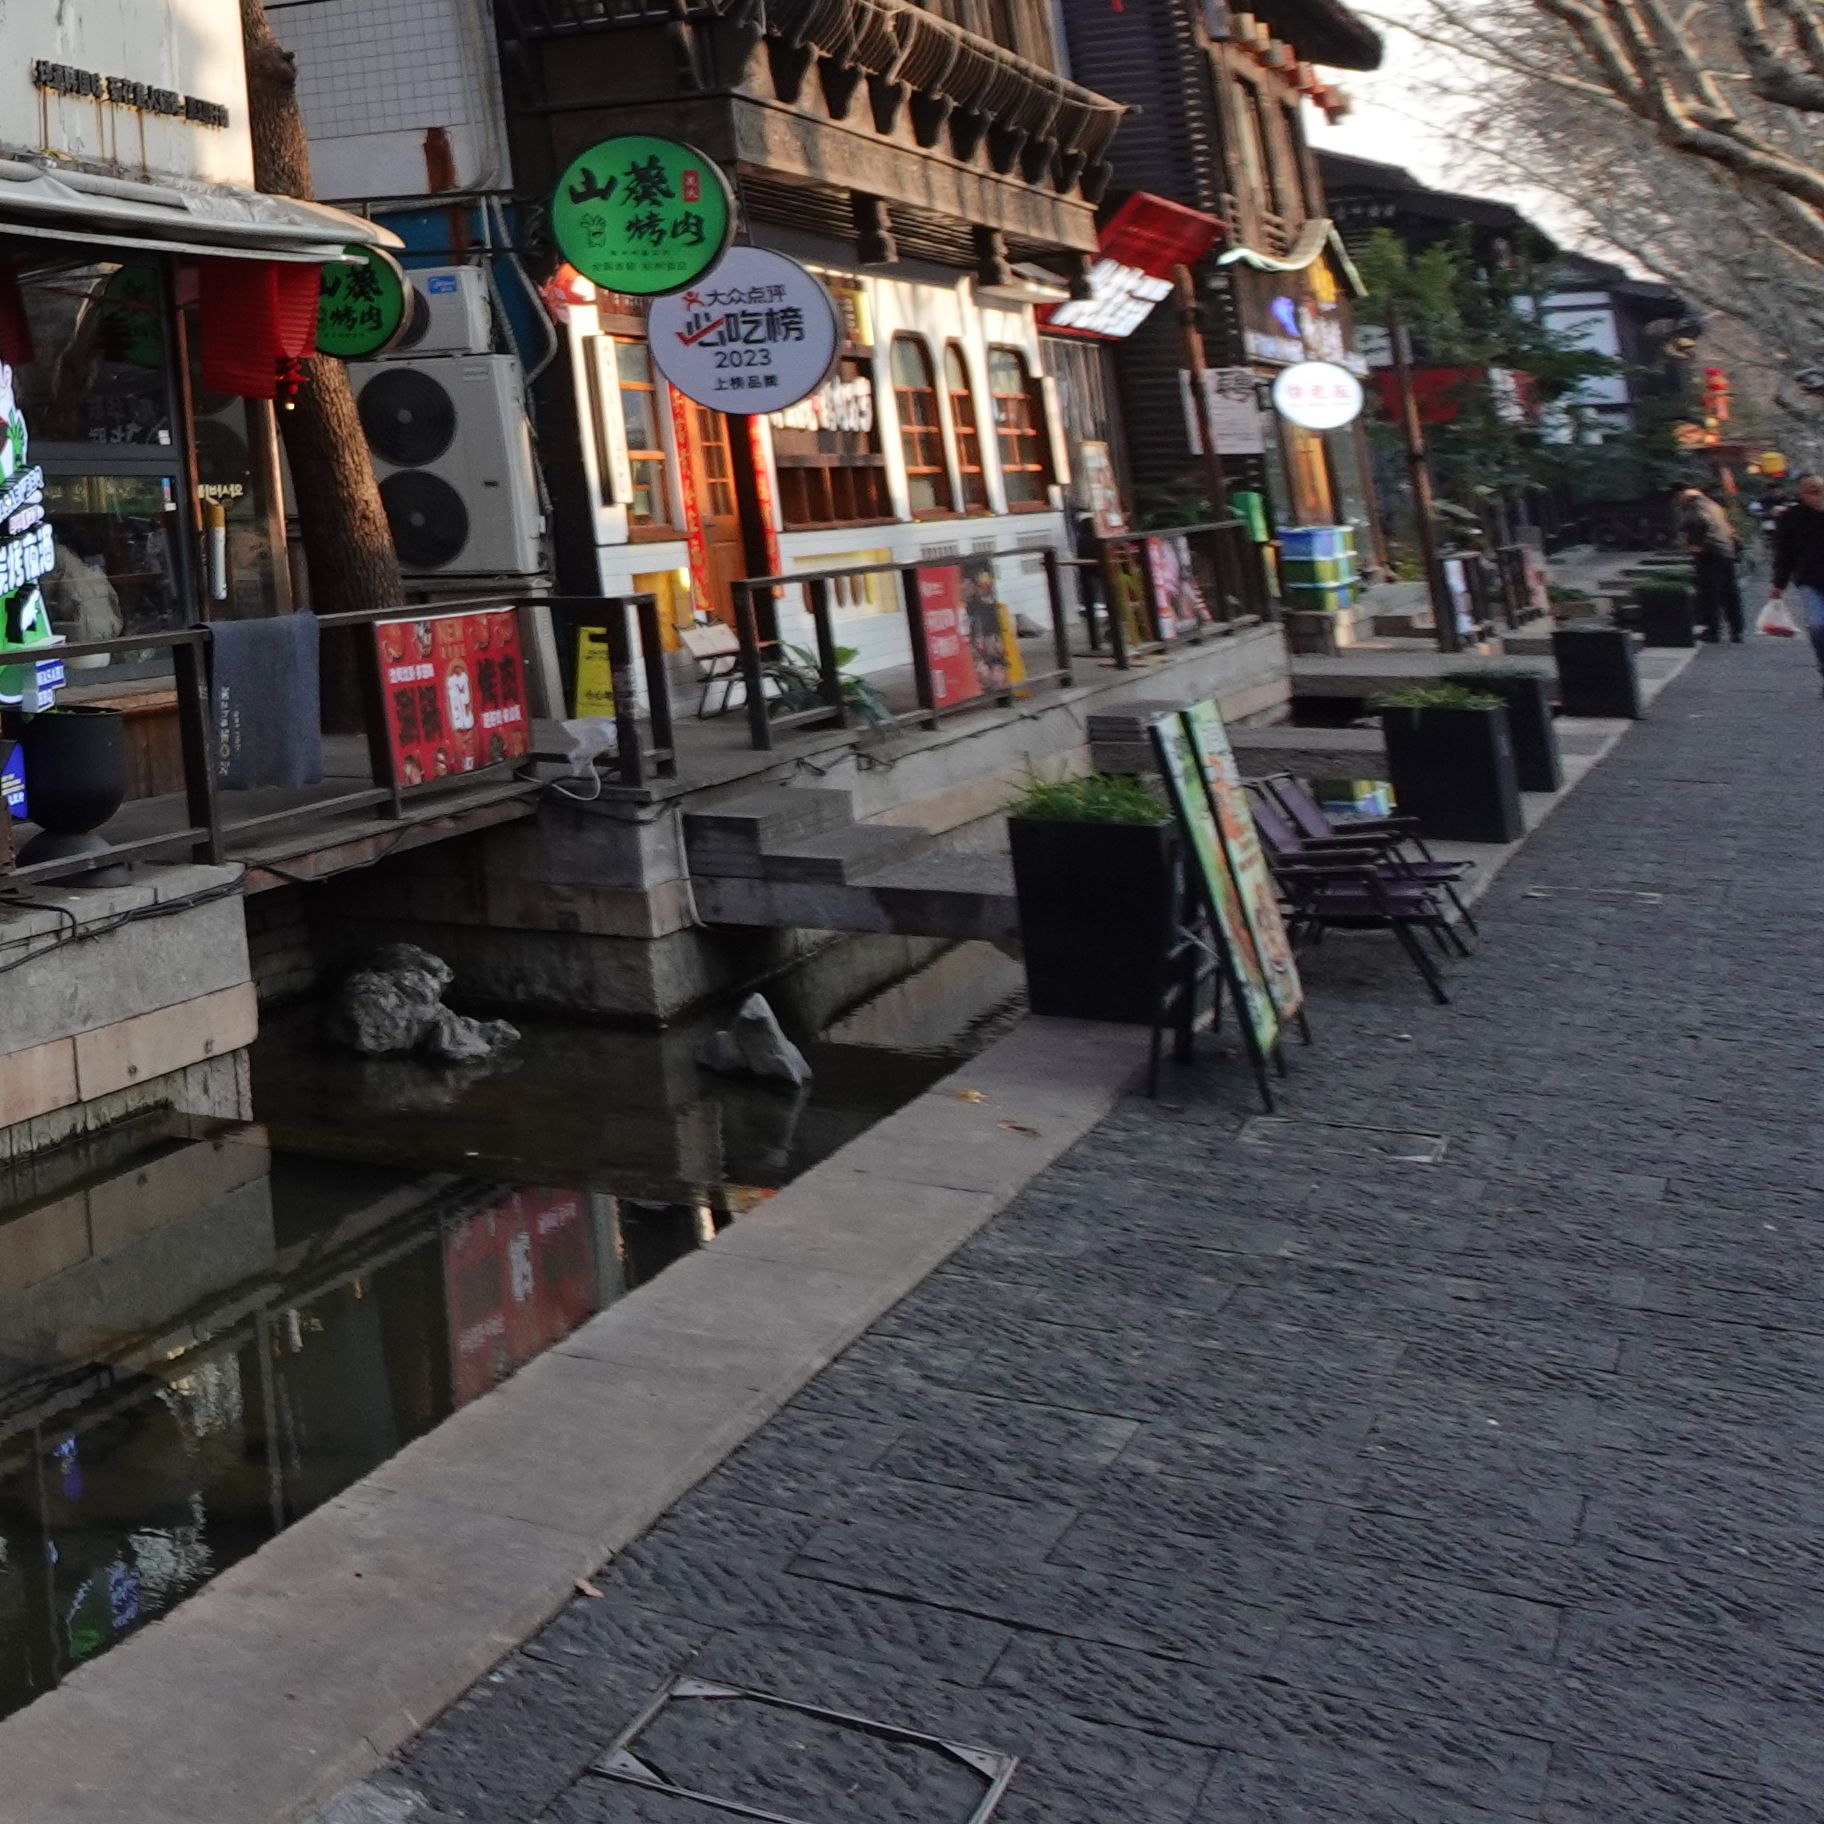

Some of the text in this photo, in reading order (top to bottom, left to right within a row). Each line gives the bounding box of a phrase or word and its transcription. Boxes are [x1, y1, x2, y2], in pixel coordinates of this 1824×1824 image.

[568, 154, 676, 207] 山葵
[625, 211, 705, 247] 烤肉
[706, 284, 787, 306] 大众点评
[676, 306, 806, 347] 必吃榜
[714, 349, 772, 369] 2023
